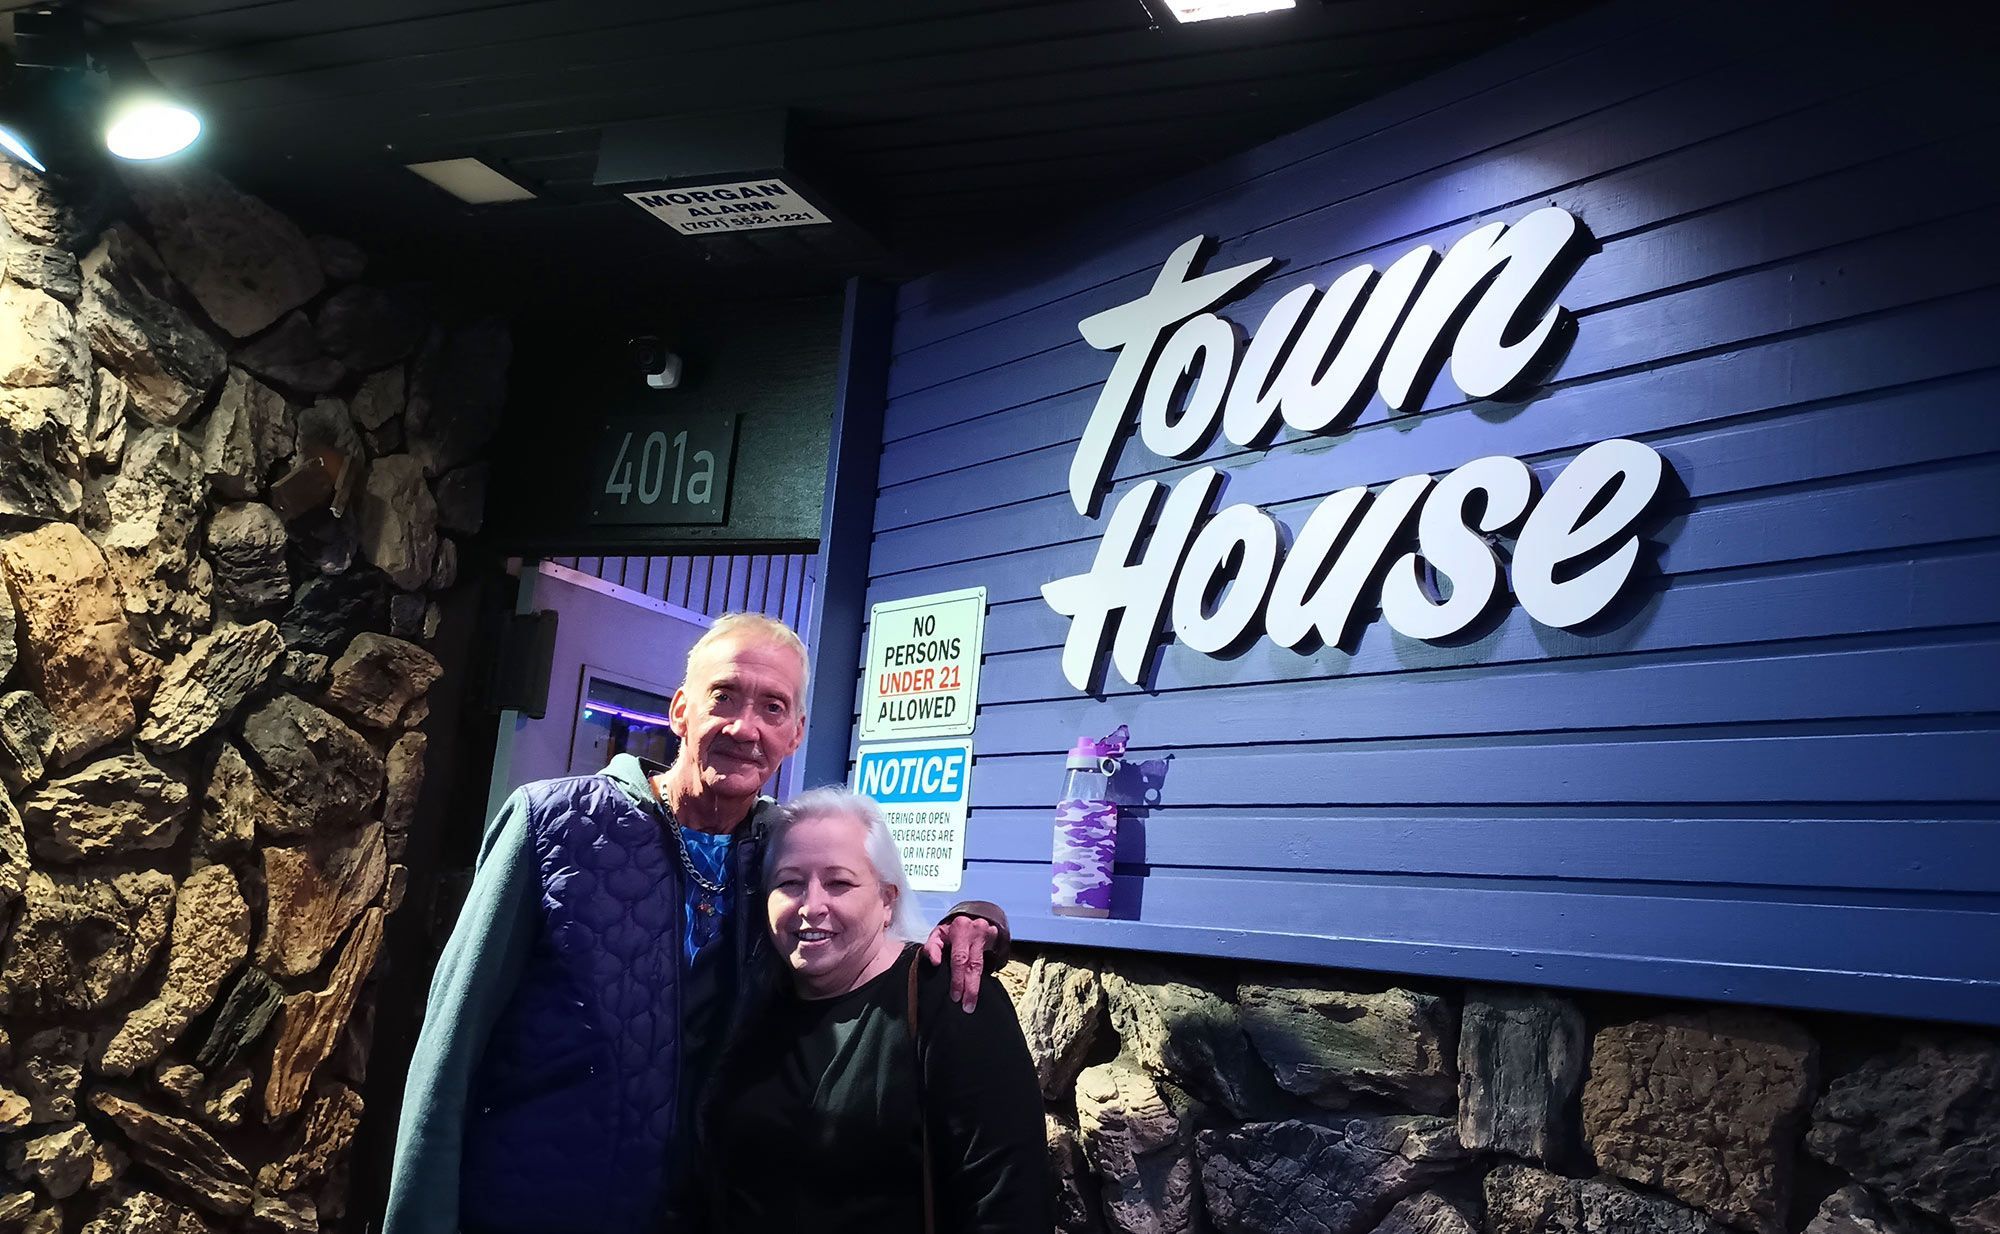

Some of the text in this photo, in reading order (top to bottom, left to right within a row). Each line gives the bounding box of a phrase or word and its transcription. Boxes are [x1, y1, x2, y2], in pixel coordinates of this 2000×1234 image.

[636, 183, 788, 208] MORGAN
[687, 201, 778, 218] ALARM
[680, 216, 730, 232] (707)
[605, 430, 715, 505] 401a
[913, 614, 936, 638] NO
[884, 637, 961, 668] PERSONS
[879, 665, 961, 695] UNDER 21
[878, 695, 957, 723] ALLOWED
[861, 755, 963, 796] NOTICE
[886, 812, 951, 824] TERING OR OPEN
[938, 829, 955, 842] ARE
[903, 846, 914, 859] OR
[915, 847, 925, 859] IN
[926, 846, 953, 860] FRONT
[904, 863, 940, 877] REMISES
